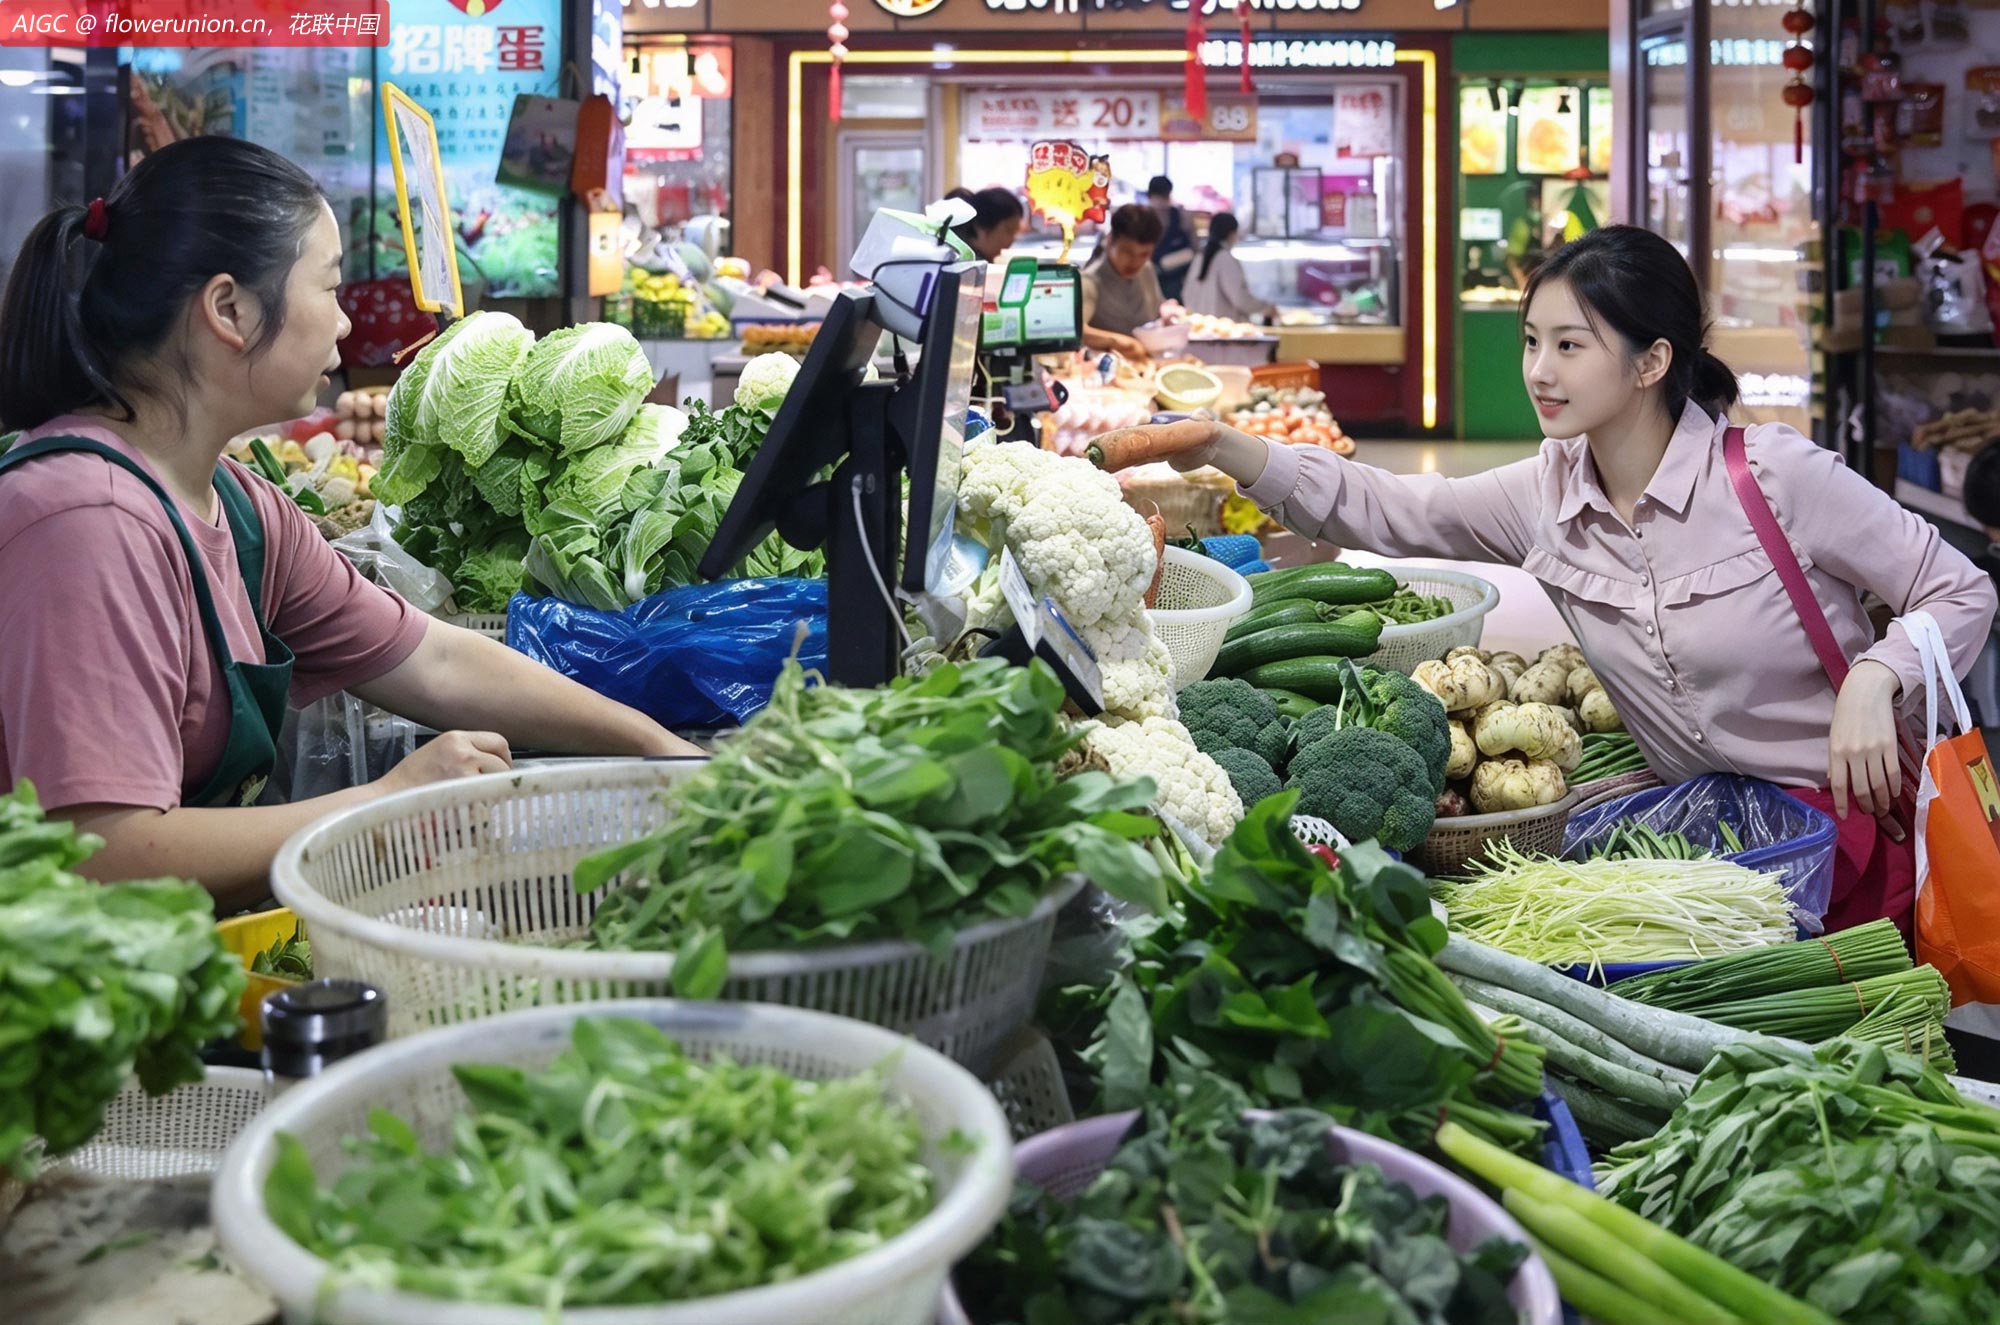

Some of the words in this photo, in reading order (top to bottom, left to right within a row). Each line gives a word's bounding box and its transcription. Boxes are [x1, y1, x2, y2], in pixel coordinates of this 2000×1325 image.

[389, 24, 545, 75] 招牌蛋
[1092, 97, 1133, 127] 20
